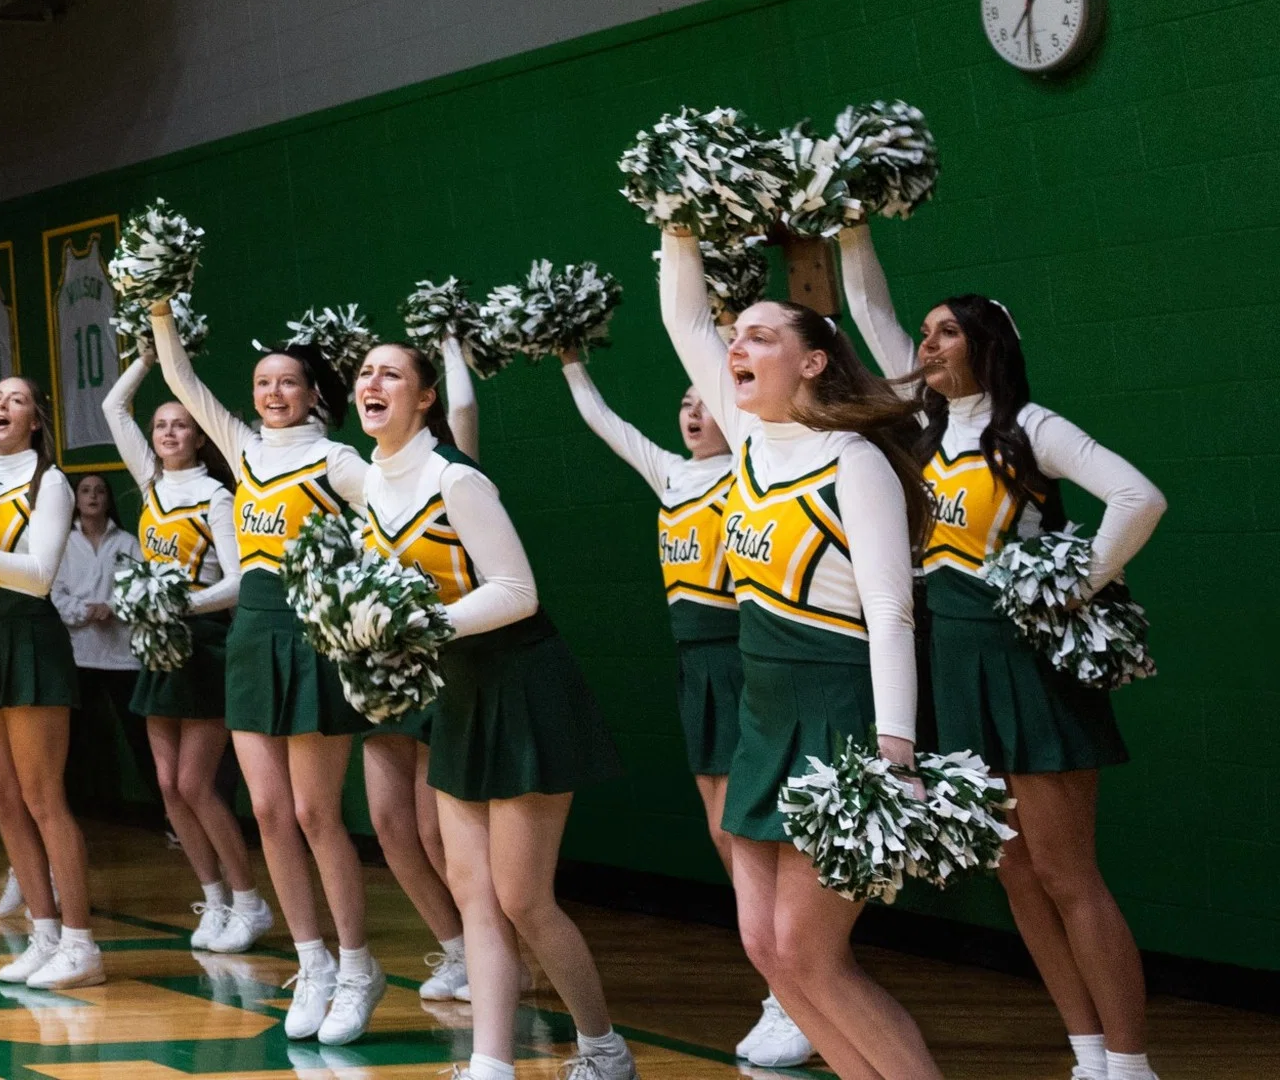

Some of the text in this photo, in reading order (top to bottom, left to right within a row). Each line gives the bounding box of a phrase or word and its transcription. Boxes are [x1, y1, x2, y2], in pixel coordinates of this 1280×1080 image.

[991, 6, 1000, 20] 9
[1061, 14, 1071, 28] 4
[1014, 40, 1022, 54] 7
[1051, 33, 1060, 48] 5
[74, 323, 103, 390] 10
[241, 502, 286, 536] Irish
[145, 526, 179, 559] Irish
[660, 528, 700, 564] Irish
[724, 514, 775, 562] Irish
